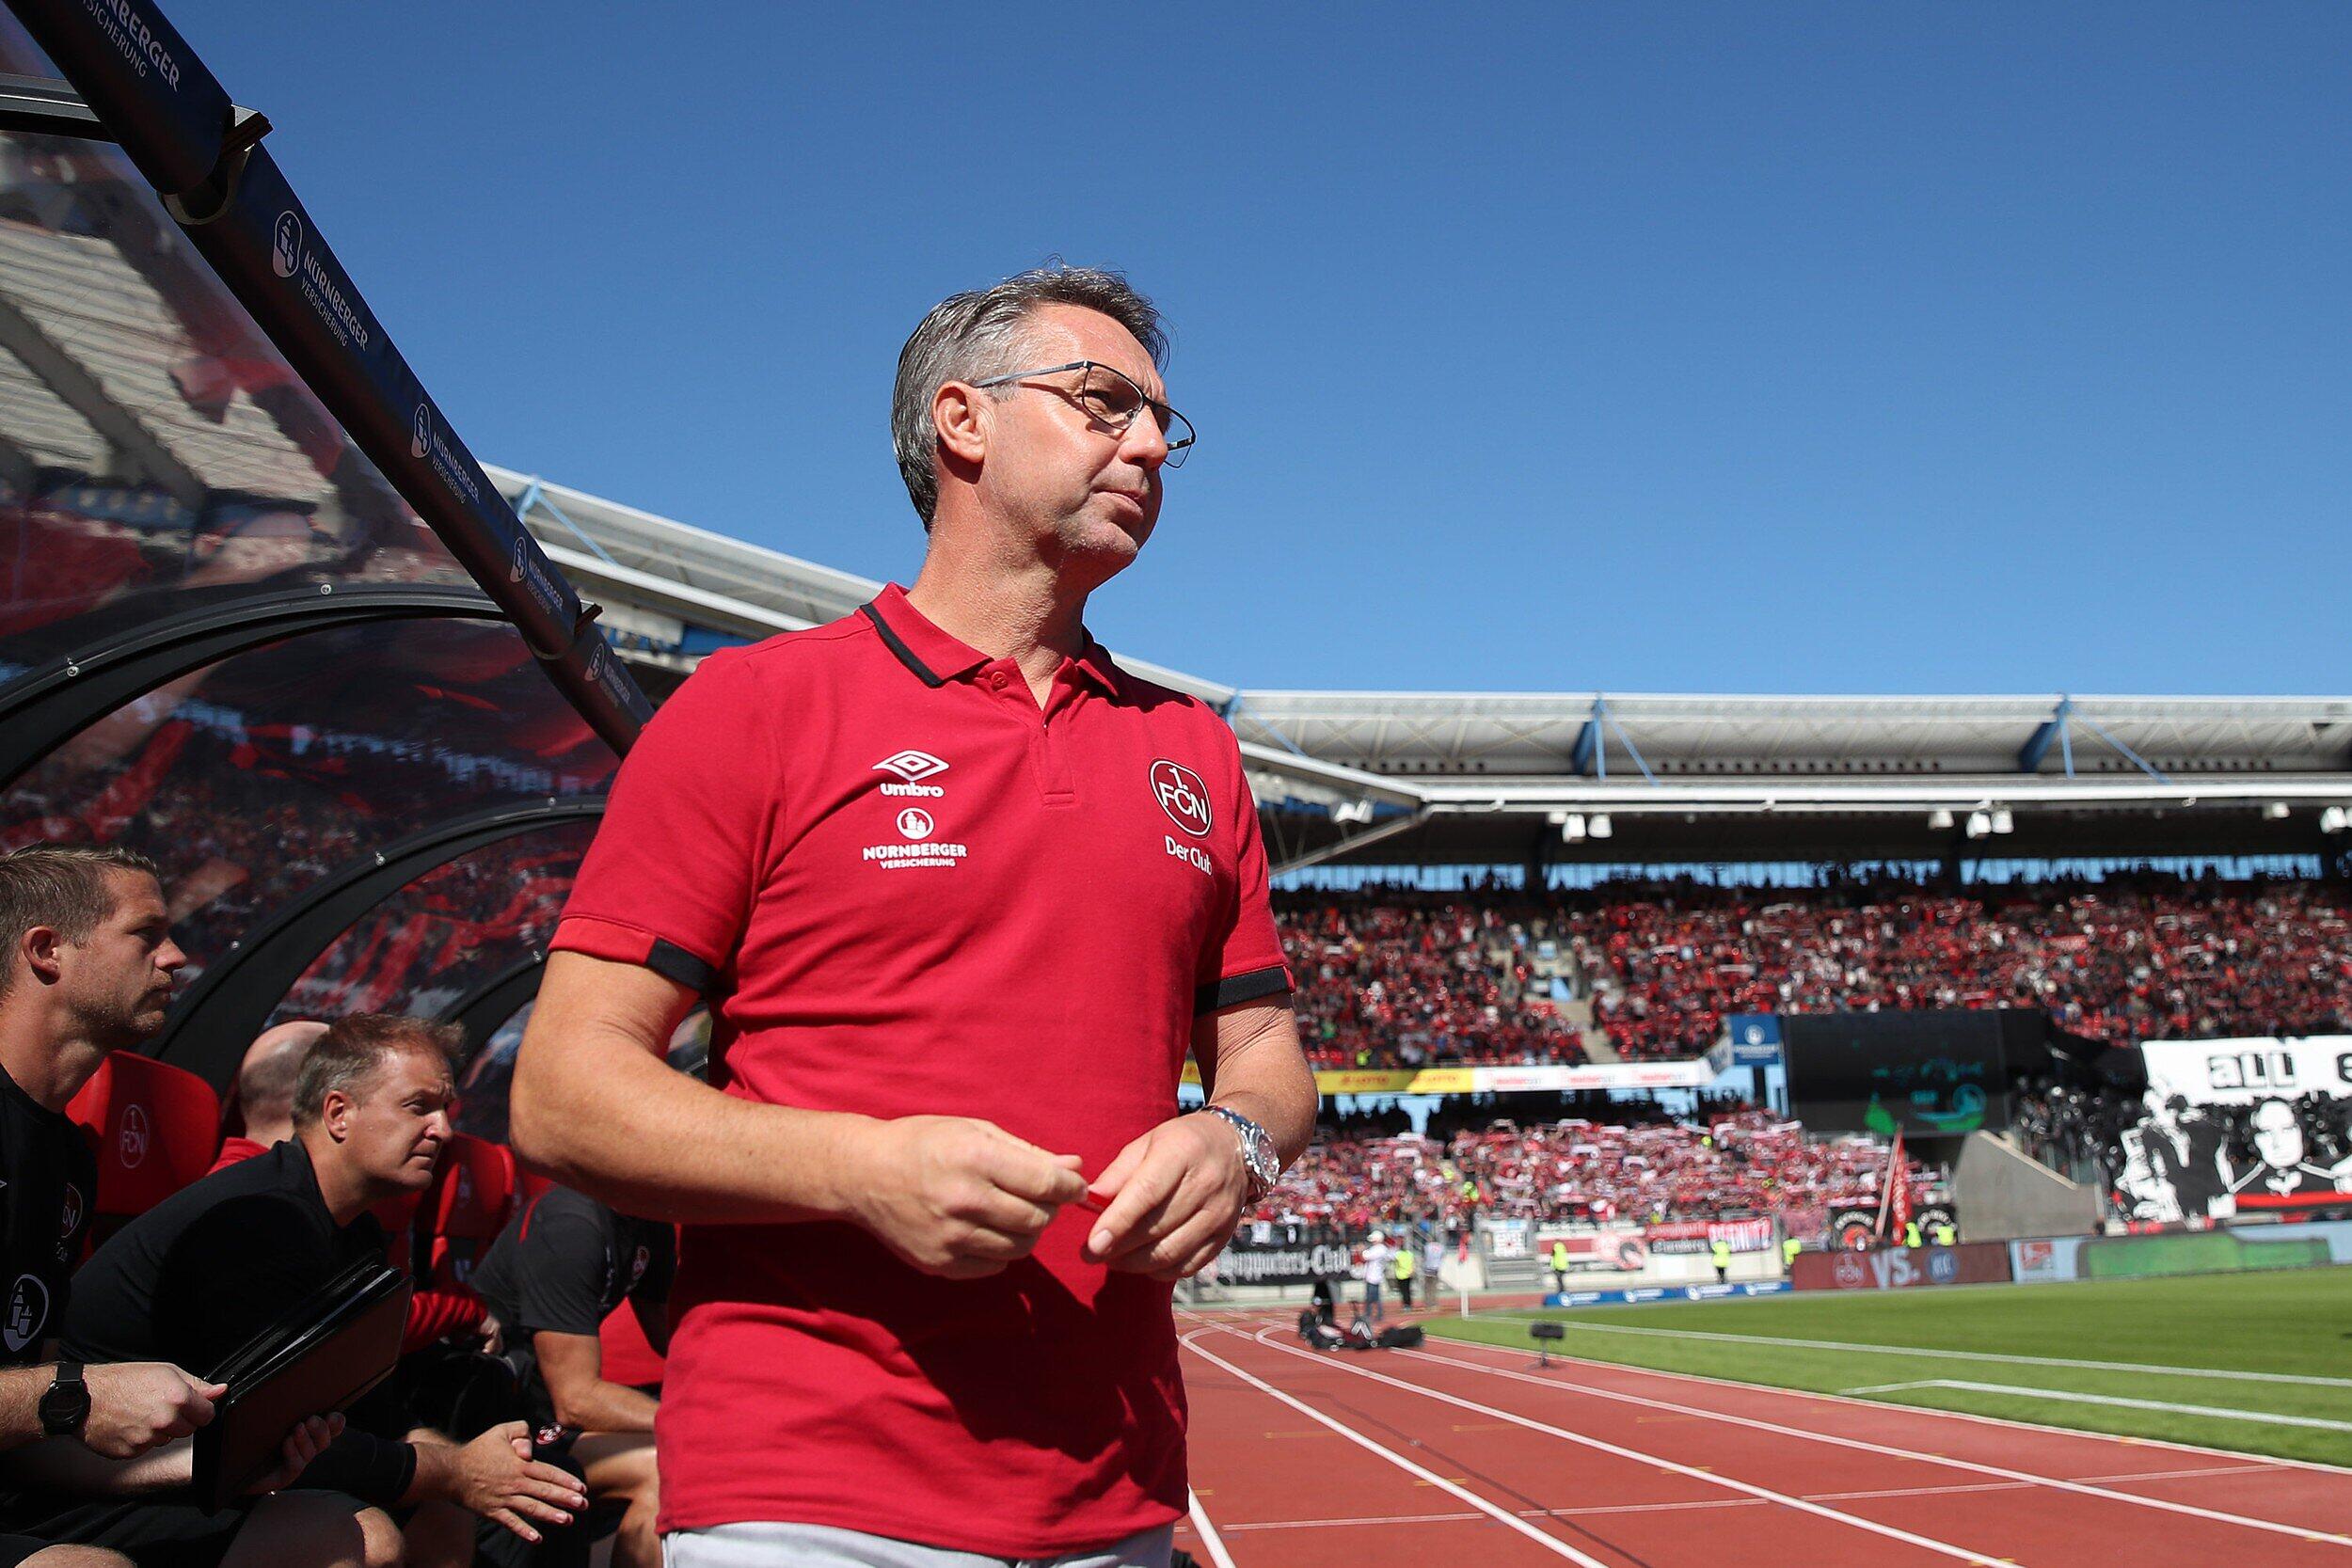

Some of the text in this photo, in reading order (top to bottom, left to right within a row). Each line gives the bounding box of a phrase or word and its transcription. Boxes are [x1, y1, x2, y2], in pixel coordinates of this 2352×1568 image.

[301, 277, 349, 347] VERSICHERUNG
[303, 249, 369, 352] NÜRNBERGER
[880, 782, 945, 798] umbro
[1158, 782, 1208, 824] FCN
[863, 842, 967, 861] NÜRNBERGER
[880, 858, 956, 869] VERSICHERUNG
[1165, 835, 1213, 876] Der Club
[1870, 1246, 1921, 1290] VS.
